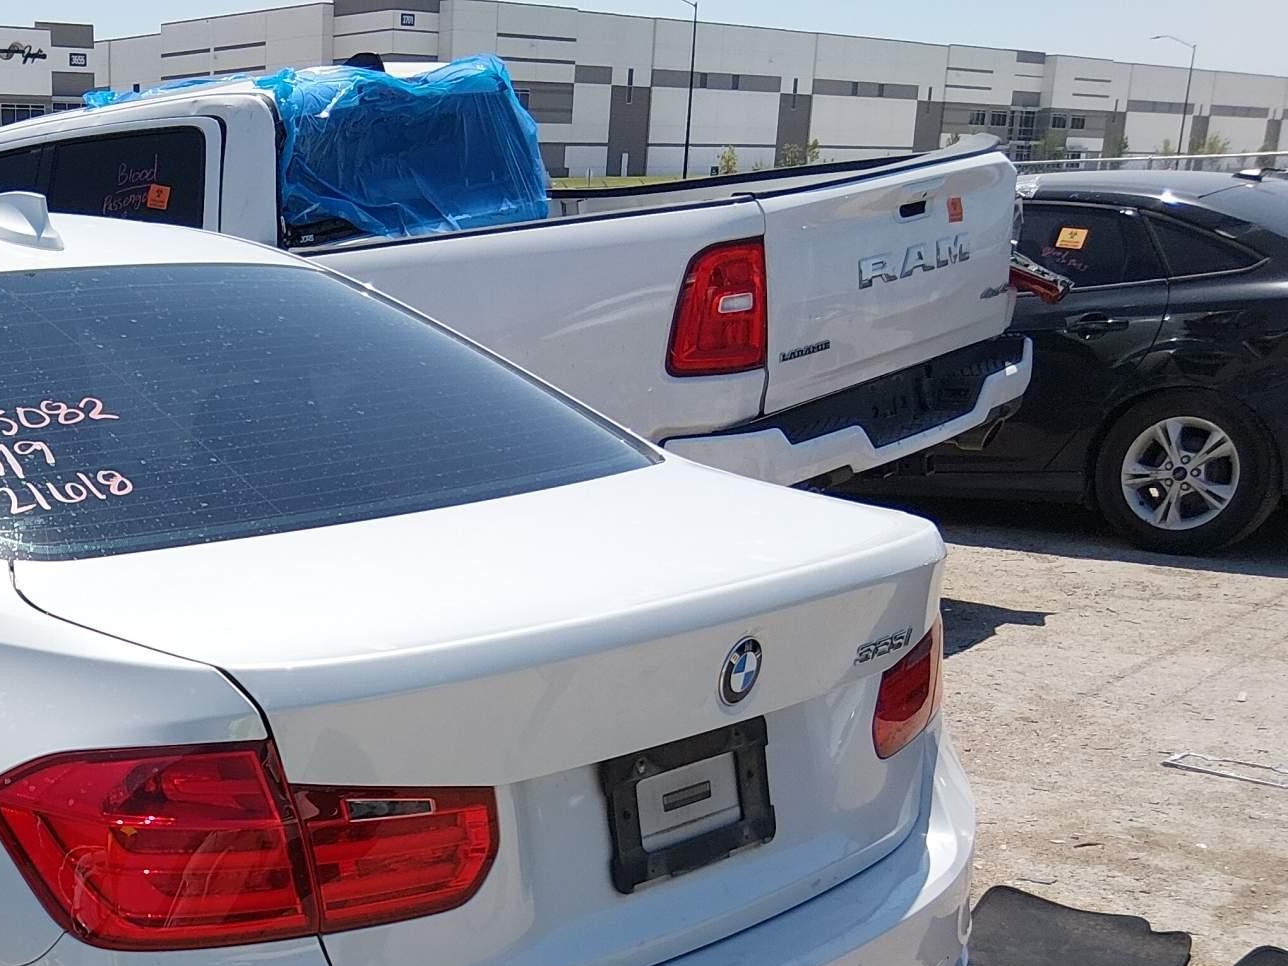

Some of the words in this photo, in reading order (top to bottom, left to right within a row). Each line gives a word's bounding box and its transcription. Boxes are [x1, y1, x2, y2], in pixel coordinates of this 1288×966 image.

[117, 153, 158, 186] Blood
[858, 231, 971, 290] RAM
[778, 340, 831, 363] LARAMIE
